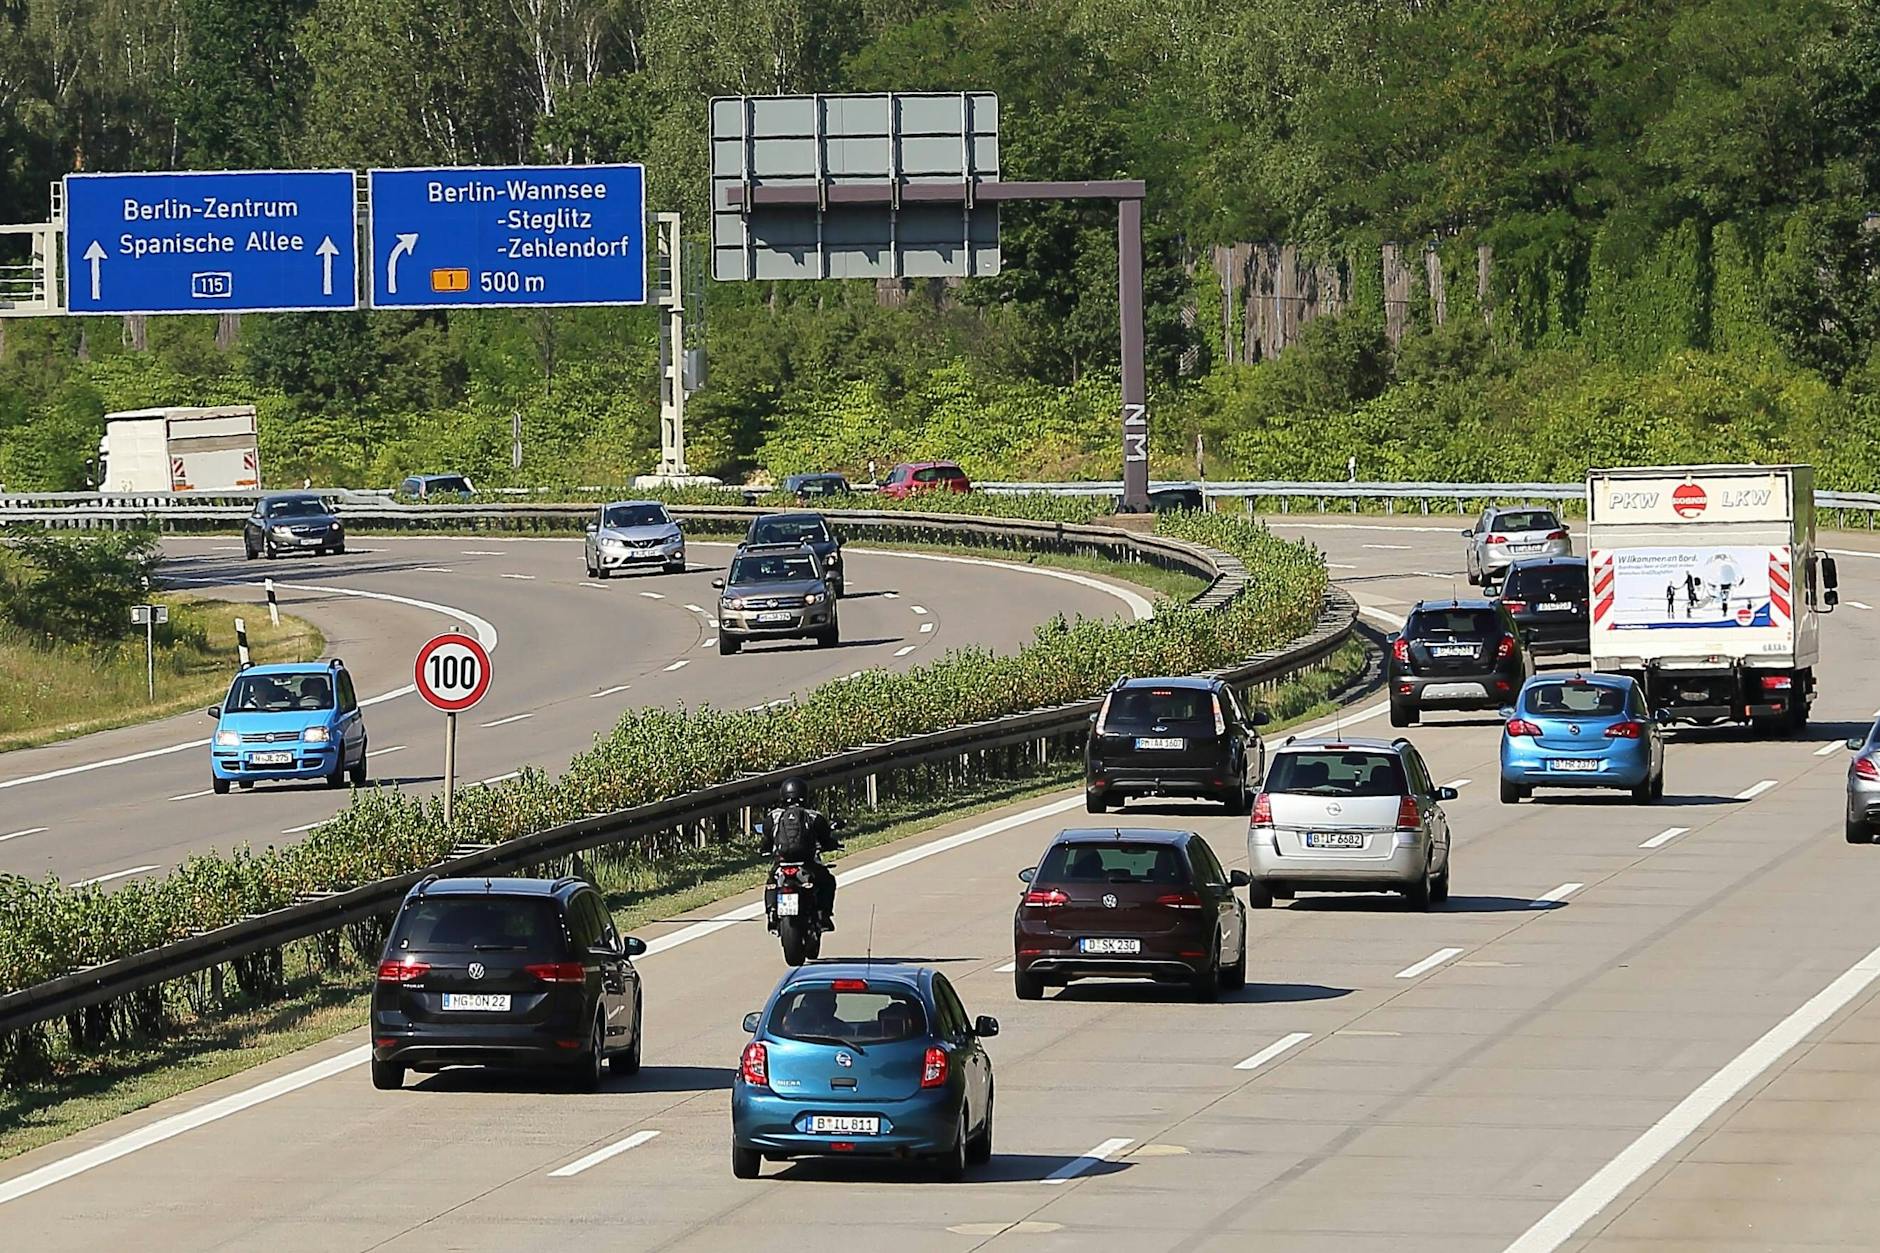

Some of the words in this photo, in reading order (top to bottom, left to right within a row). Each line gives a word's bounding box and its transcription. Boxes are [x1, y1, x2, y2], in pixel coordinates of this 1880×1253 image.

[427, 180, 607, 202] Berlin-Wannsee
[123, 197, 298, 221] Berlin-Zentrum
[496, 208, 593, 234] -Steglitz
[119, 232, 235, 259] Spanische
[245, 231, 304, 252] Allee
[496, 236, 630, 259] -Zehlendorf
[200, 277, 223, 294] 115
[447, 273, 454, 287] 1
[480, 271, 520, 293] 500
[524, 274, 545, 291] m
[1609, 492, 1660, 509] PKW
[1721, 489, 1772, 508] LKW
[430, 655, 475, 690] 100
[1337, 835, 1360, 844] 6682
[1102, 940, 1115, 949] SK
[1117, 940, 1136, 950] 230
[492, 996, 506, 1007] 22
[817, 1118, 825, 1129] B
[851, 1119, 873, 1130] 811
